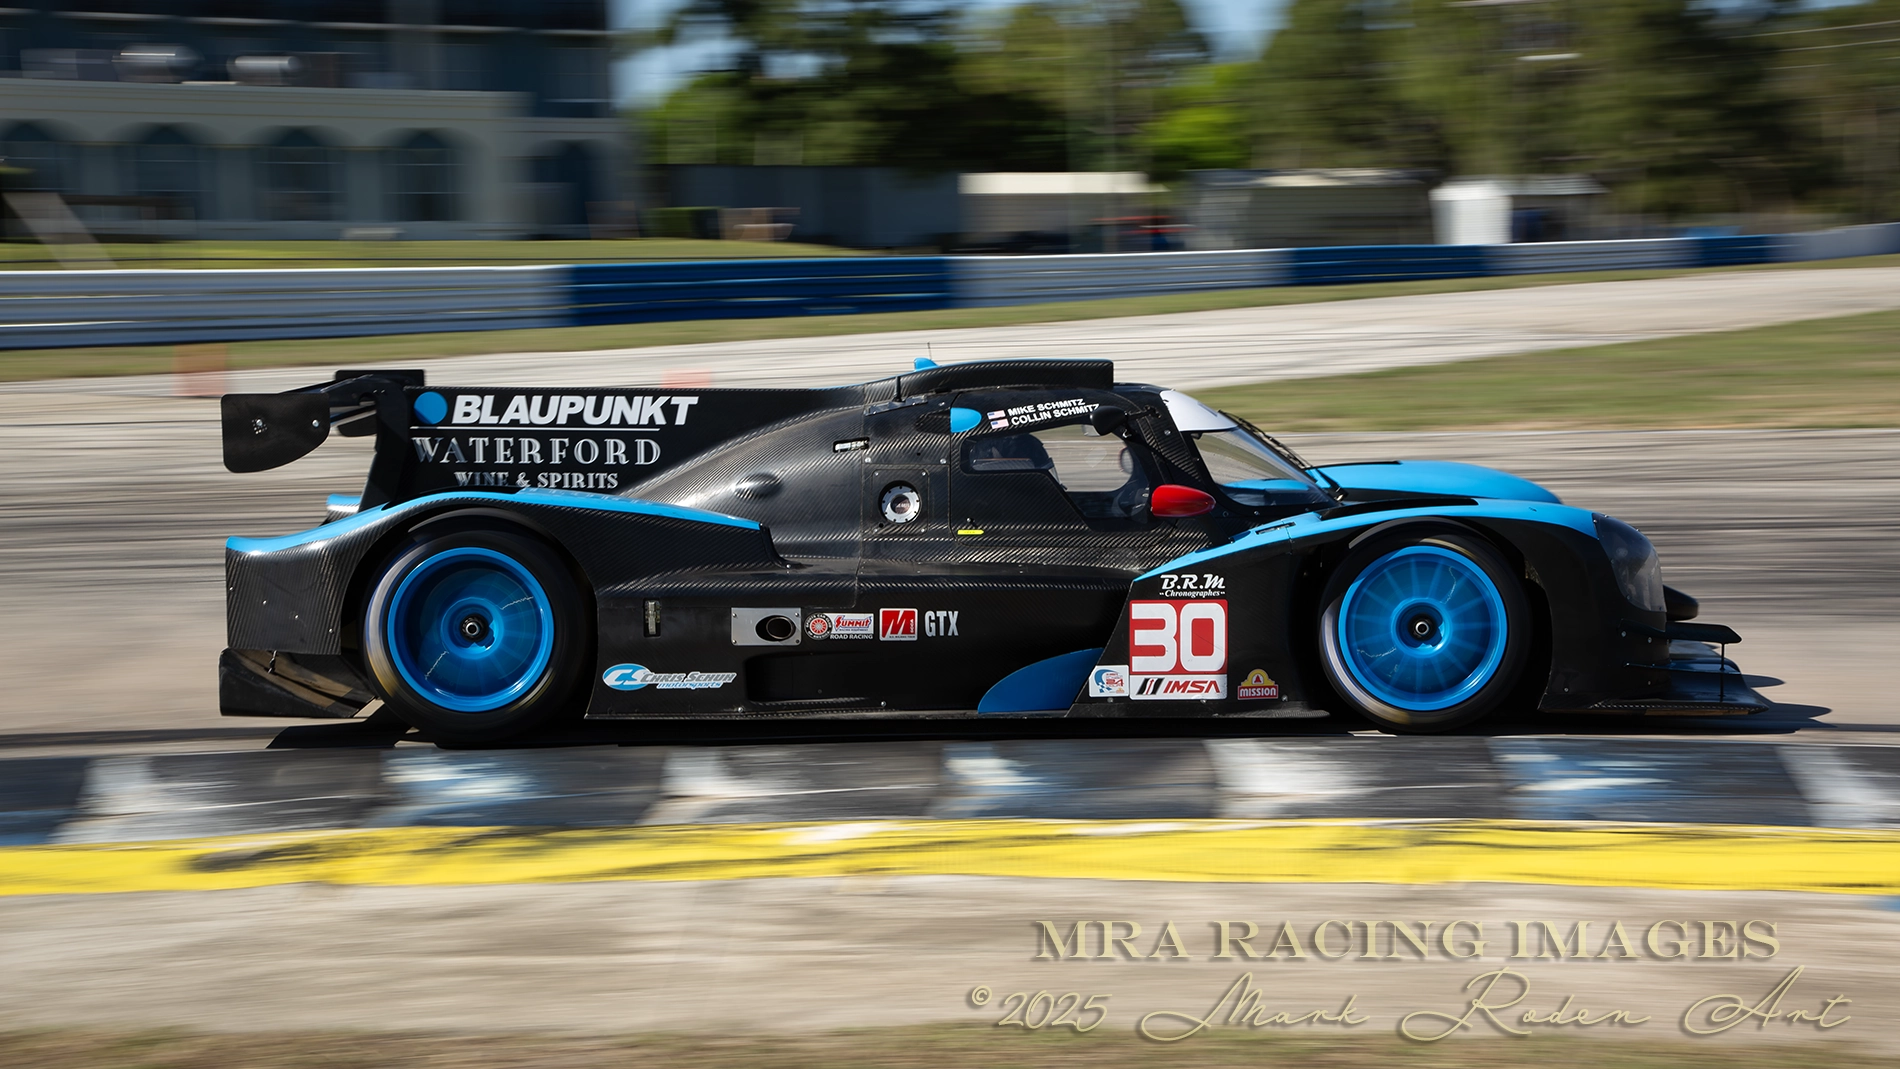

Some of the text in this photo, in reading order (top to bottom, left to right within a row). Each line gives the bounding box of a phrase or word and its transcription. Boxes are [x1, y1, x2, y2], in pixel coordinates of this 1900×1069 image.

[451, 394, 700, 426] BLAUPUNKT
[1007, 398, 1086, 417] MIKE SCHMITZ
[1010, 411, 1053, 426] COLLIN
[410, 436, 662, 466] WATERFORD
[453, 470, 620, 490] WINE & SPIRITS
[1159, 573, 1226, 590] B.R.M
[924, 610, 959, 637] GTX
[1131, 602, 1226, 673] 30
[1163, 680, 1220, 693] IMSA
